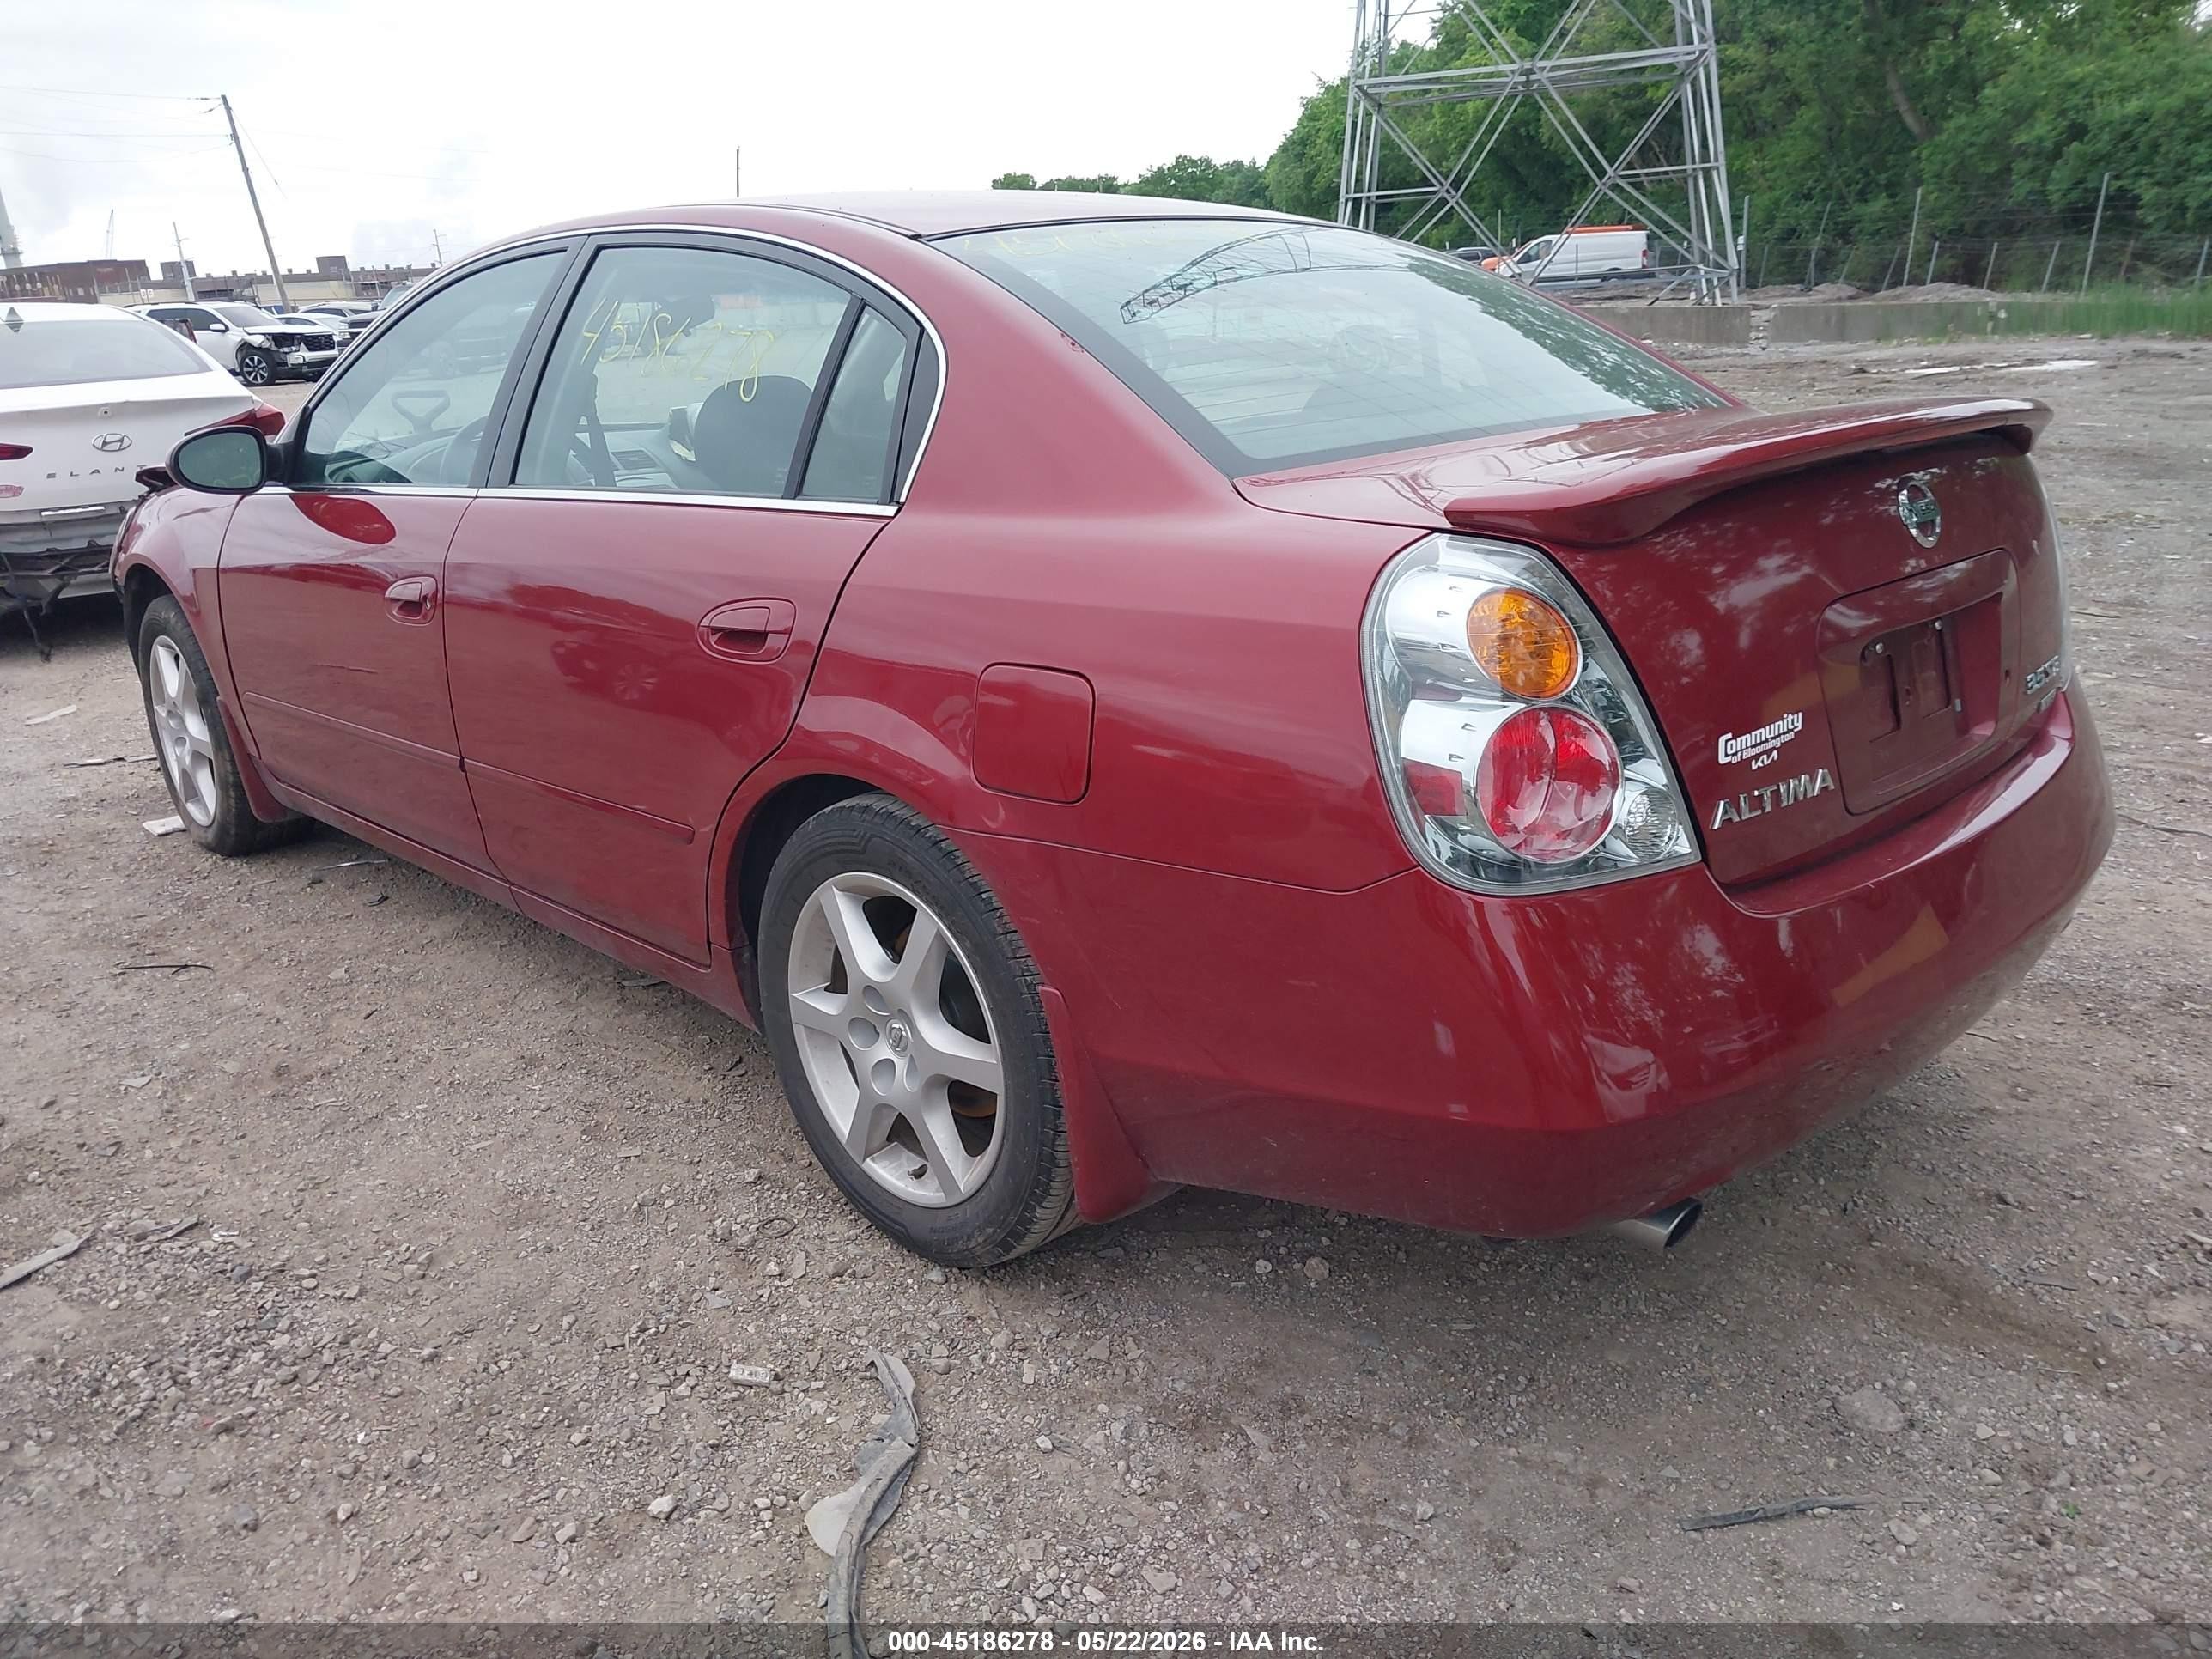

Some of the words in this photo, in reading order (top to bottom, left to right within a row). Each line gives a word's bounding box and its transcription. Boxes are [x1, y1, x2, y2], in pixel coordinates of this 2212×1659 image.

[1718, 712, 1802, 764] Community
[1731, 750, 1742, 764] of
[1742, 732, 1795, 760] Bloomington
[1709, 769, 1835, 830] ALTIMA
